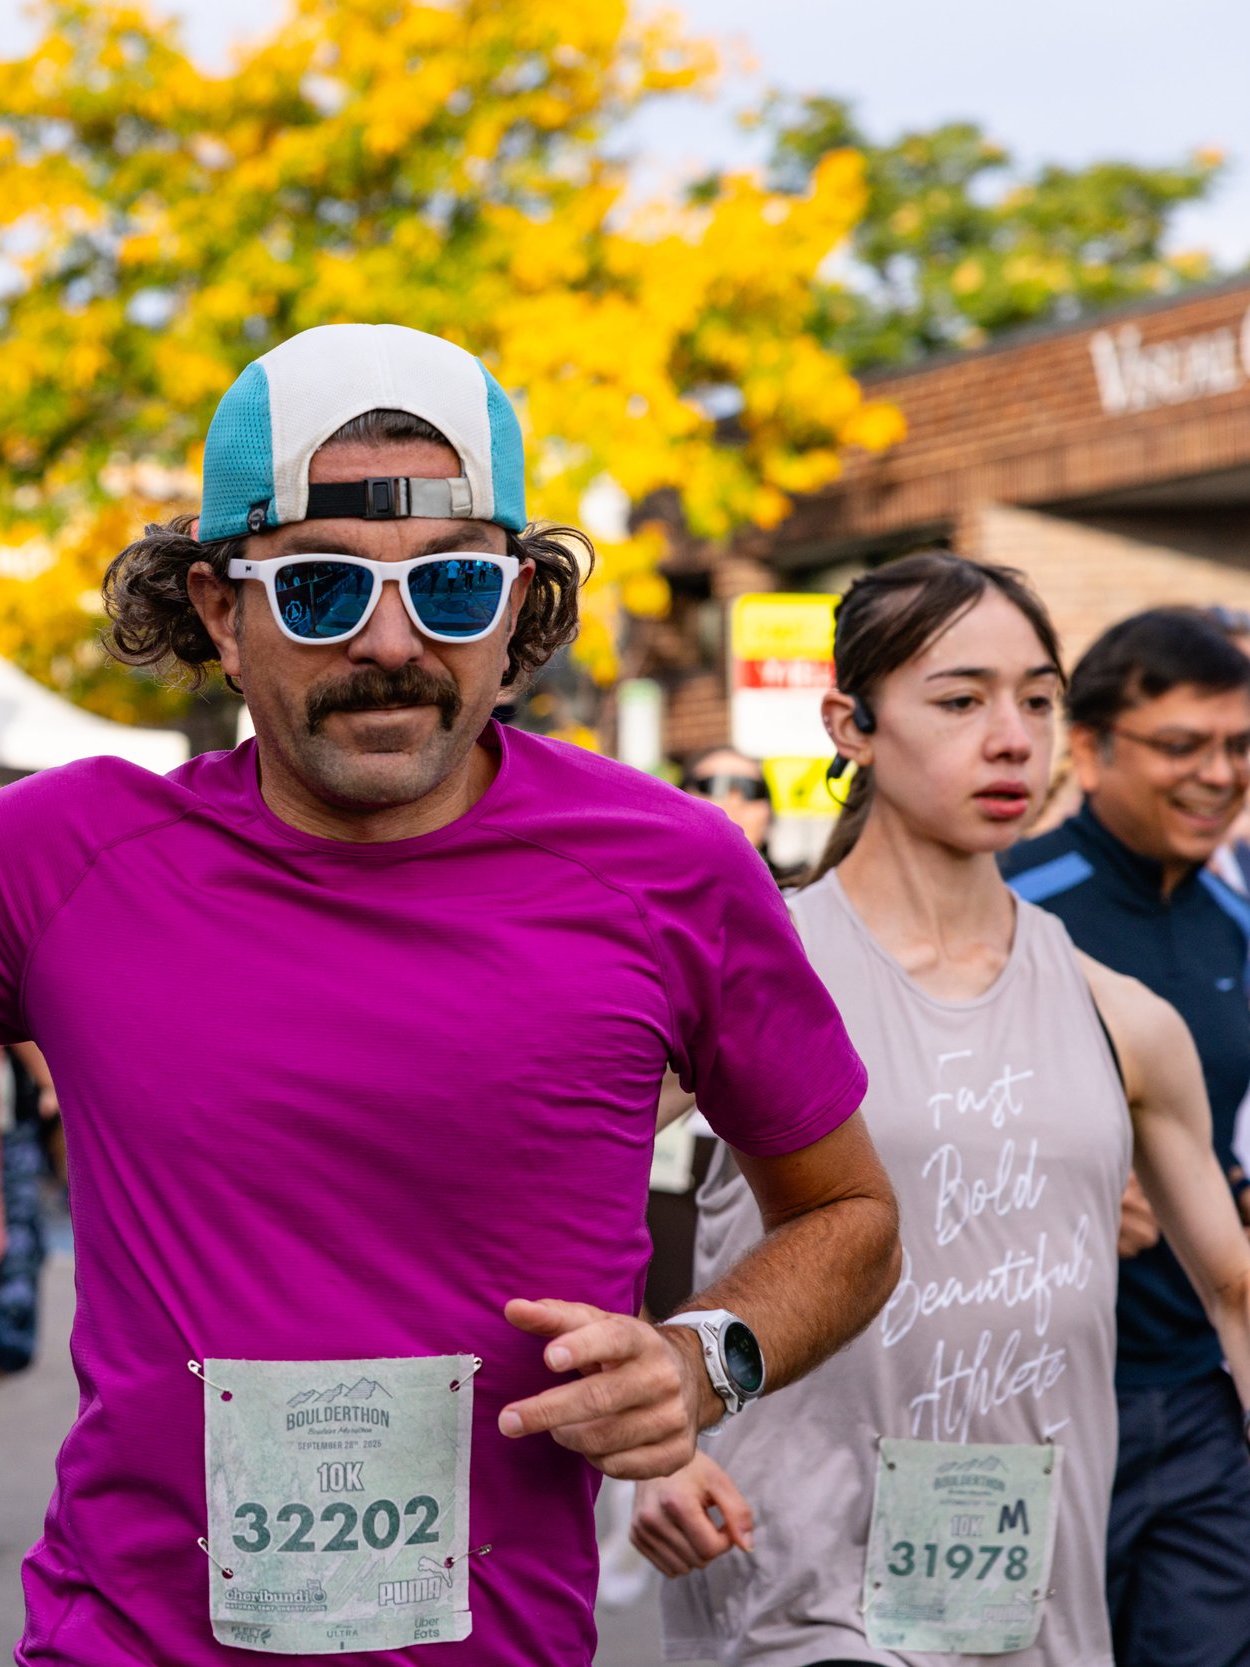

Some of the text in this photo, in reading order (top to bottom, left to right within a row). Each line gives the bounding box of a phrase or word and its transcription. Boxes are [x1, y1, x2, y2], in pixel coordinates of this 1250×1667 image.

[928, 1051, 1035, 1130] Fast
[922, 1138, 1048, 1247] Bold
[880, 1214, 1093, 1348] Beautiful
[910, 1330, 1067, 1446] Athlete
[286, 1405, 390, 1431] BOULDERTHON
[297, 1440, 343, 1451] SEPTEMBER
[317, 1461, 365, 1493] 10K
[232, 1494, 440, 1553] 32202
[951, 1513, 985, 1538] 10K
[997, 1498, 1030, 1536] M
[887, 1540, 1029, 1582] 31978
[225, 1586, 311, 1604] cheribundi
[378, 1576, 442, 1607] PUMA
[326, 1630, 358, 1638] ULTRA
[413, 1628, 440, 1640] Eats
[414, 1616, 440, 1629] Uber
